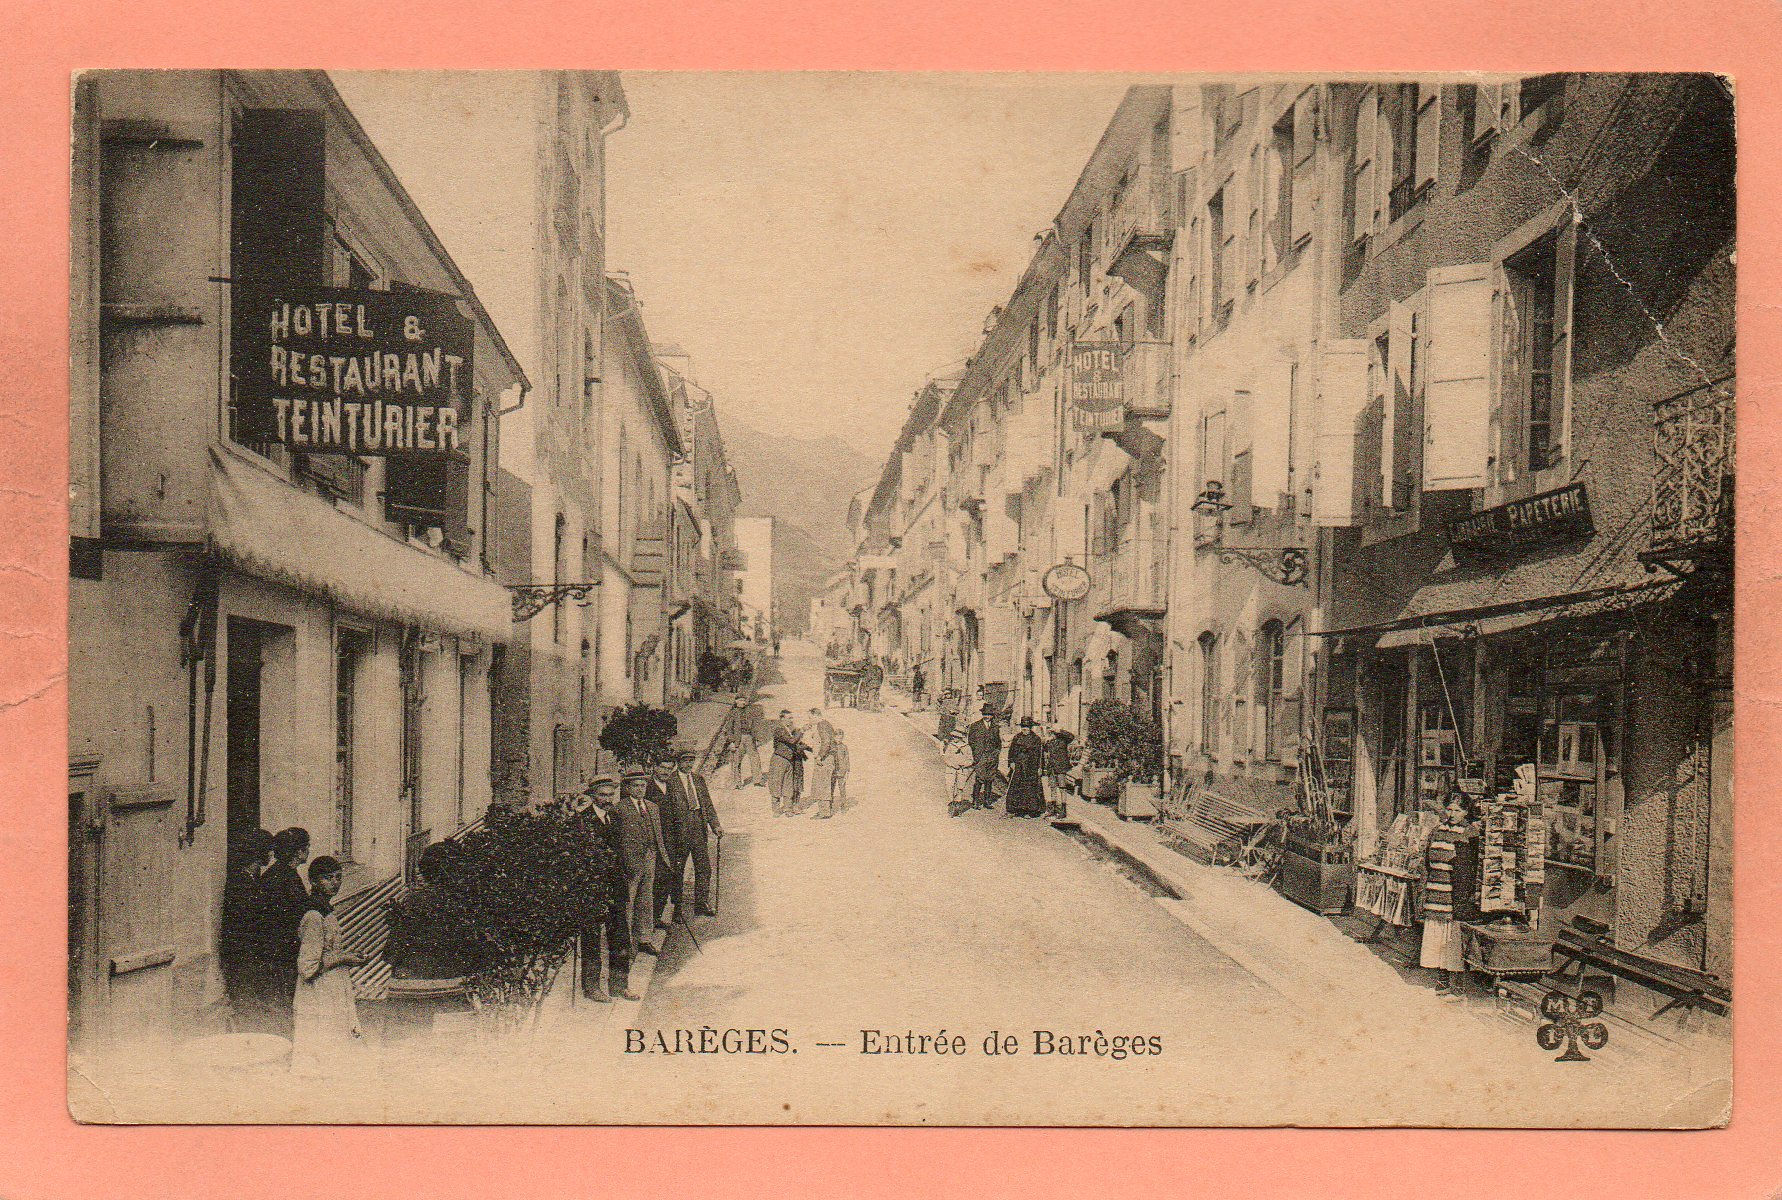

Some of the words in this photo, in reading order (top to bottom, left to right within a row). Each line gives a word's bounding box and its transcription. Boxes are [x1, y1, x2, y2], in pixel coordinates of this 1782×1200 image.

[271, 302, 374, 341] HOTEL
[403, 315, 425, 340] &
[271, 344, 464, 397] RESTAURANT
[1073, 350, 1119, 374] HOTEL
[272, 397, 459, 450] TEINTURIER
[1506, 488, 1584, 529] PAPETERIE
